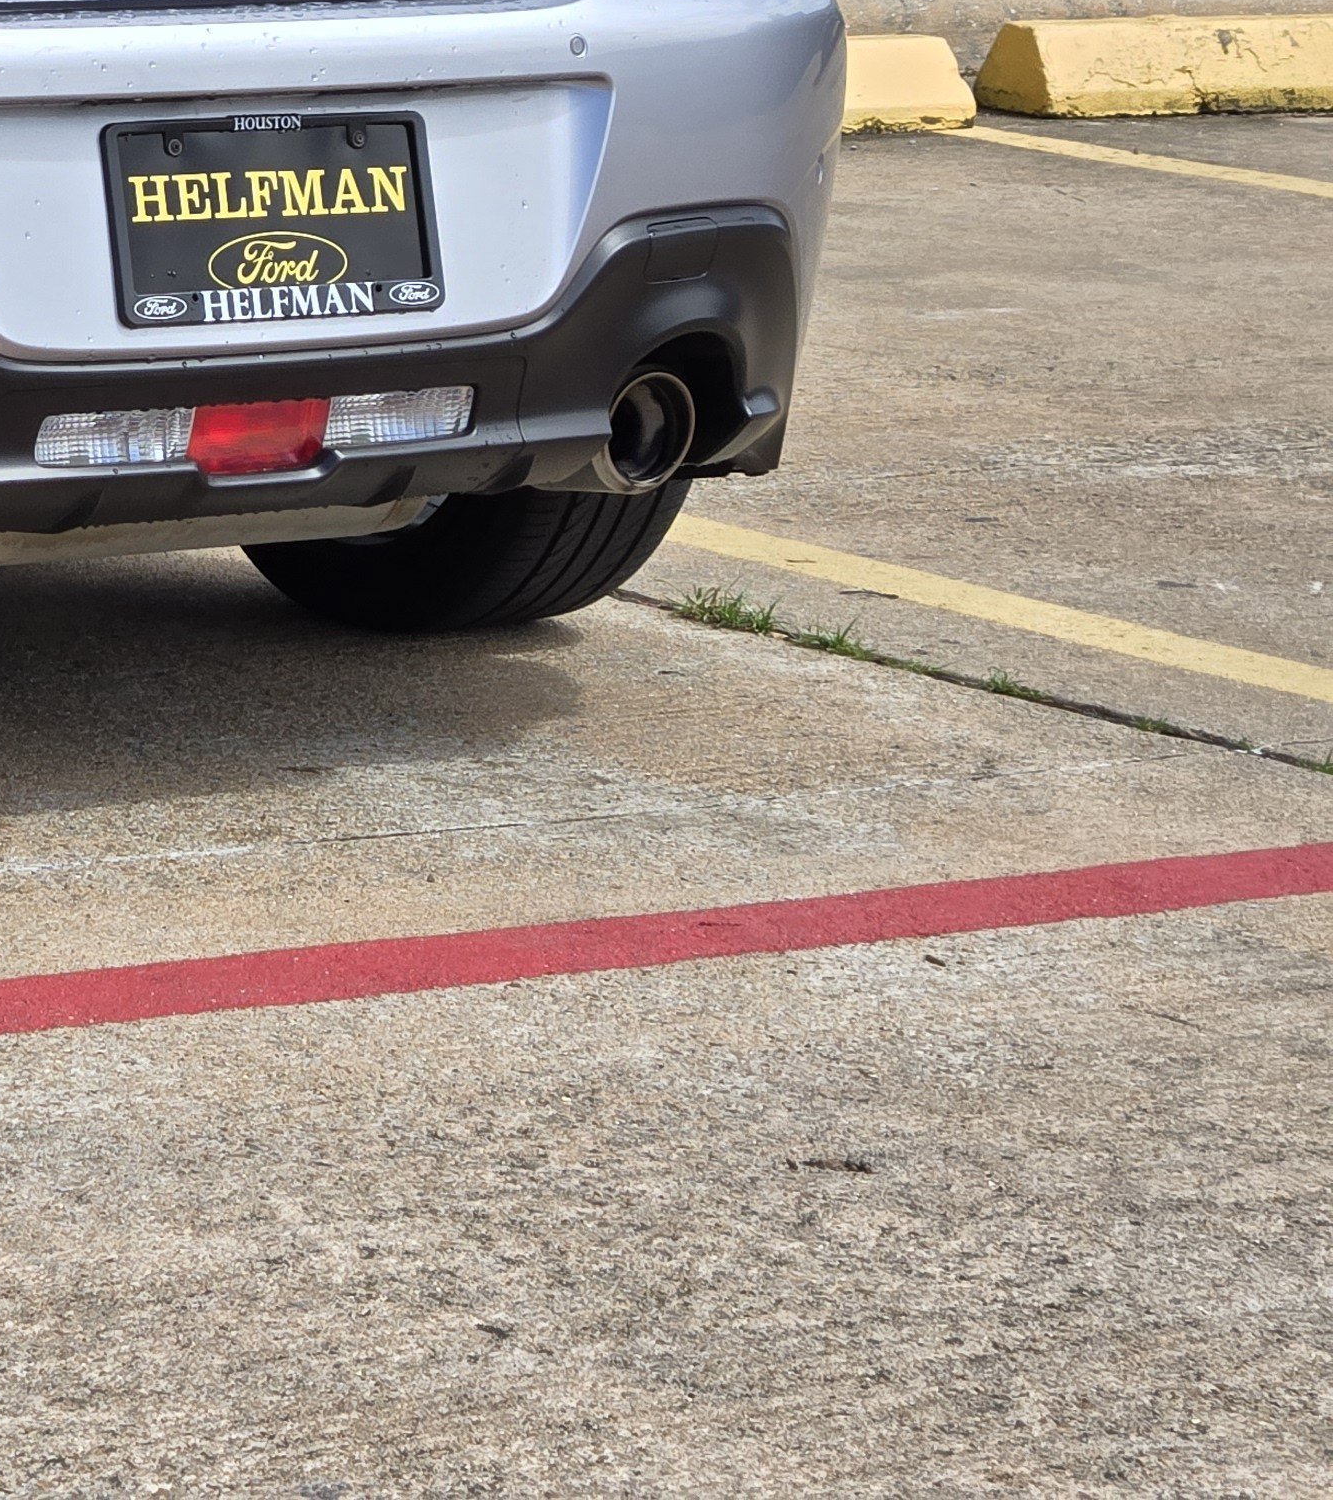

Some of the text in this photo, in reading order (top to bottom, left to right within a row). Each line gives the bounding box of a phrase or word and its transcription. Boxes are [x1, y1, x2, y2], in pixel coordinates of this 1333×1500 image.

[234, 115, 302, 131] HOUSTON
[128, 166, 407, 223] HELFMAN
[237, 240, 320, 284] Ford
[144, 299, 177, 316] Ford
[201, 282, 376, 323] HELFMAN
[398, 283, 430, 302] Ford
